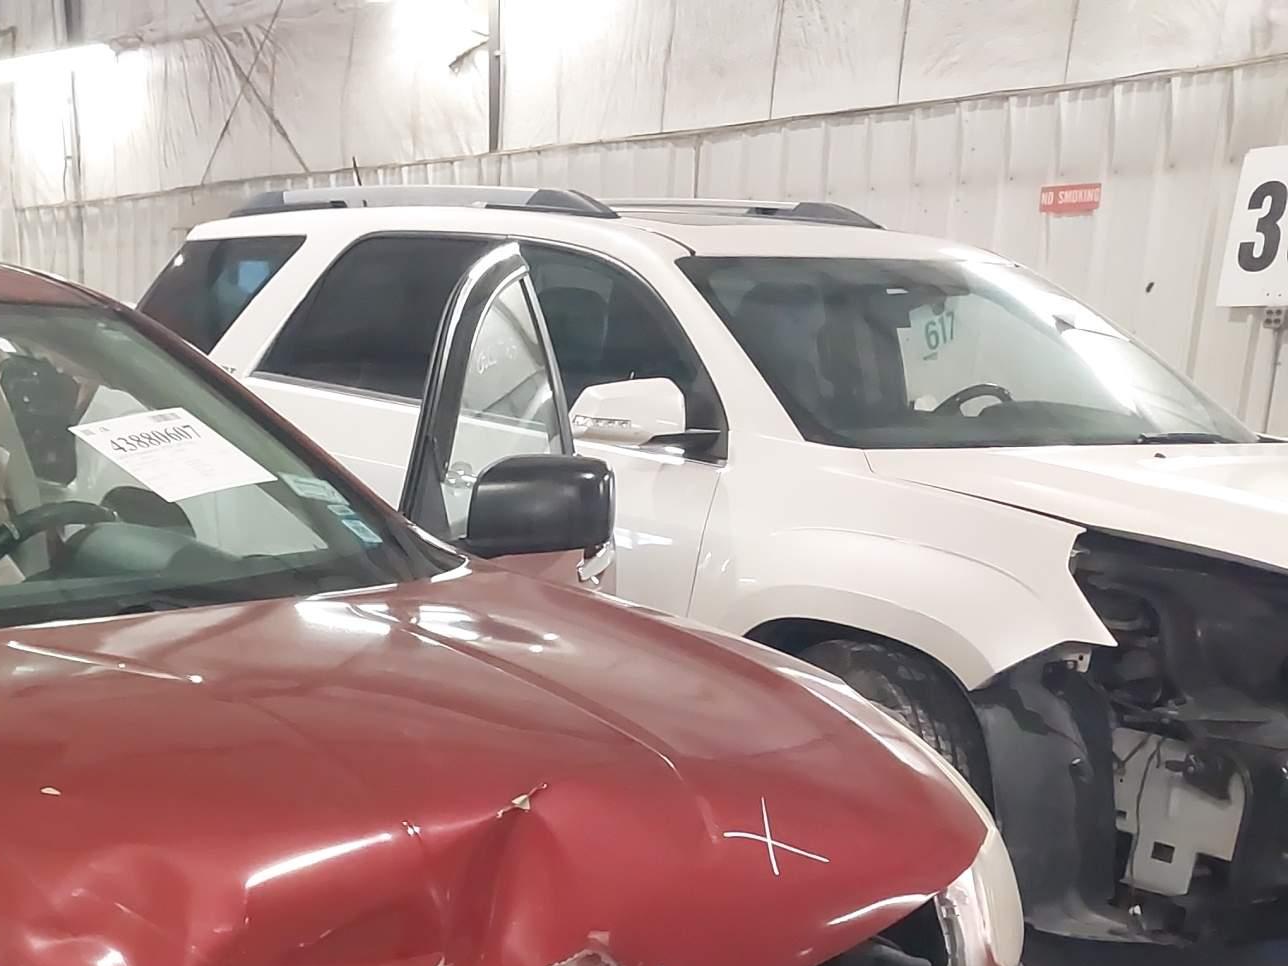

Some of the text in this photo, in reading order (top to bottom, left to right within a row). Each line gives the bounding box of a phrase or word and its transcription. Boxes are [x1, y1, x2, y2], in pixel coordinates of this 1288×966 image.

[1041, 188, 1100, 206] NO SMOKING
[110, 425, 202, 453] 43880607
